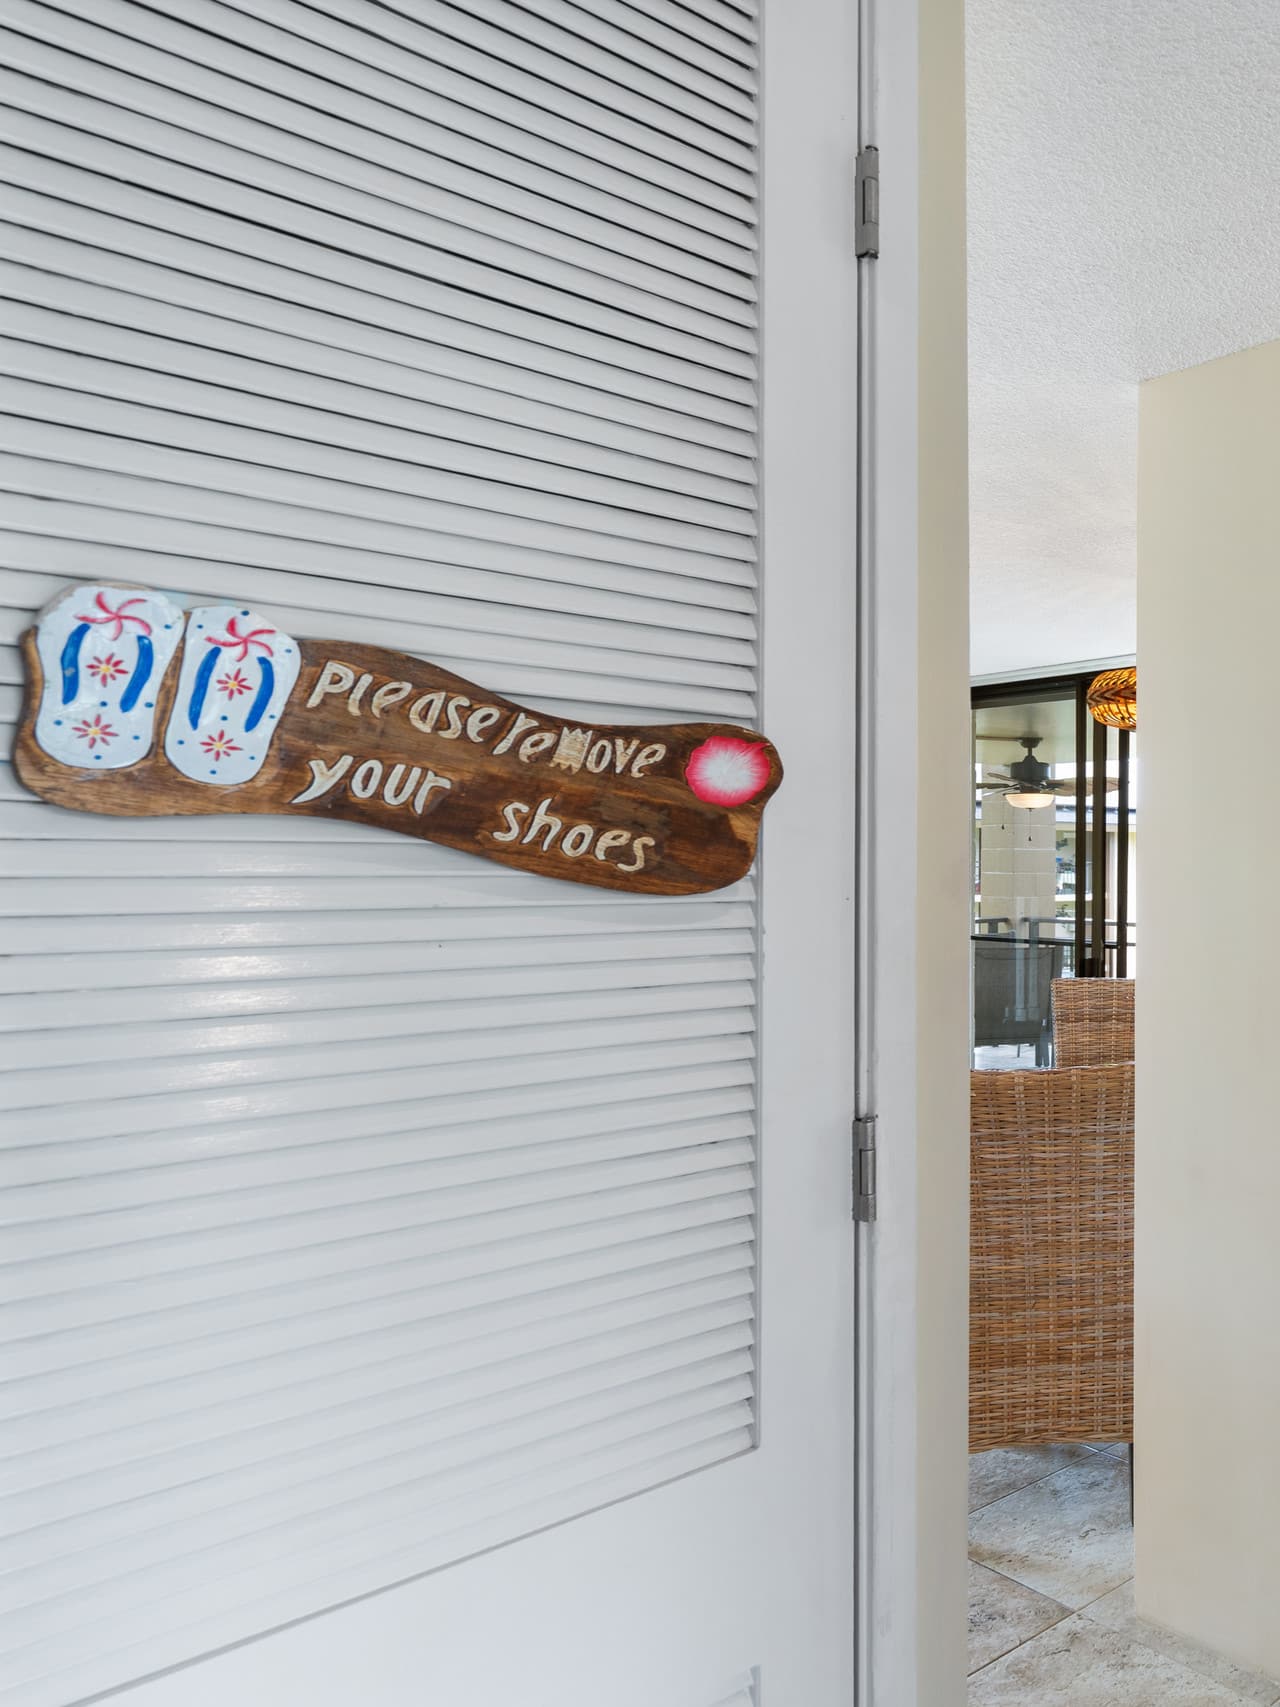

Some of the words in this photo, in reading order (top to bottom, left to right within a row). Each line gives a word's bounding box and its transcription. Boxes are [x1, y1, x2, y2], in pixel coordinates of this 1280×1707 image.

[305, 659, 501, 744] Please
[492, 711, 668, 779] remove
[290, 754, 453, 816] your
[491, 797, 656, 873] shoes
